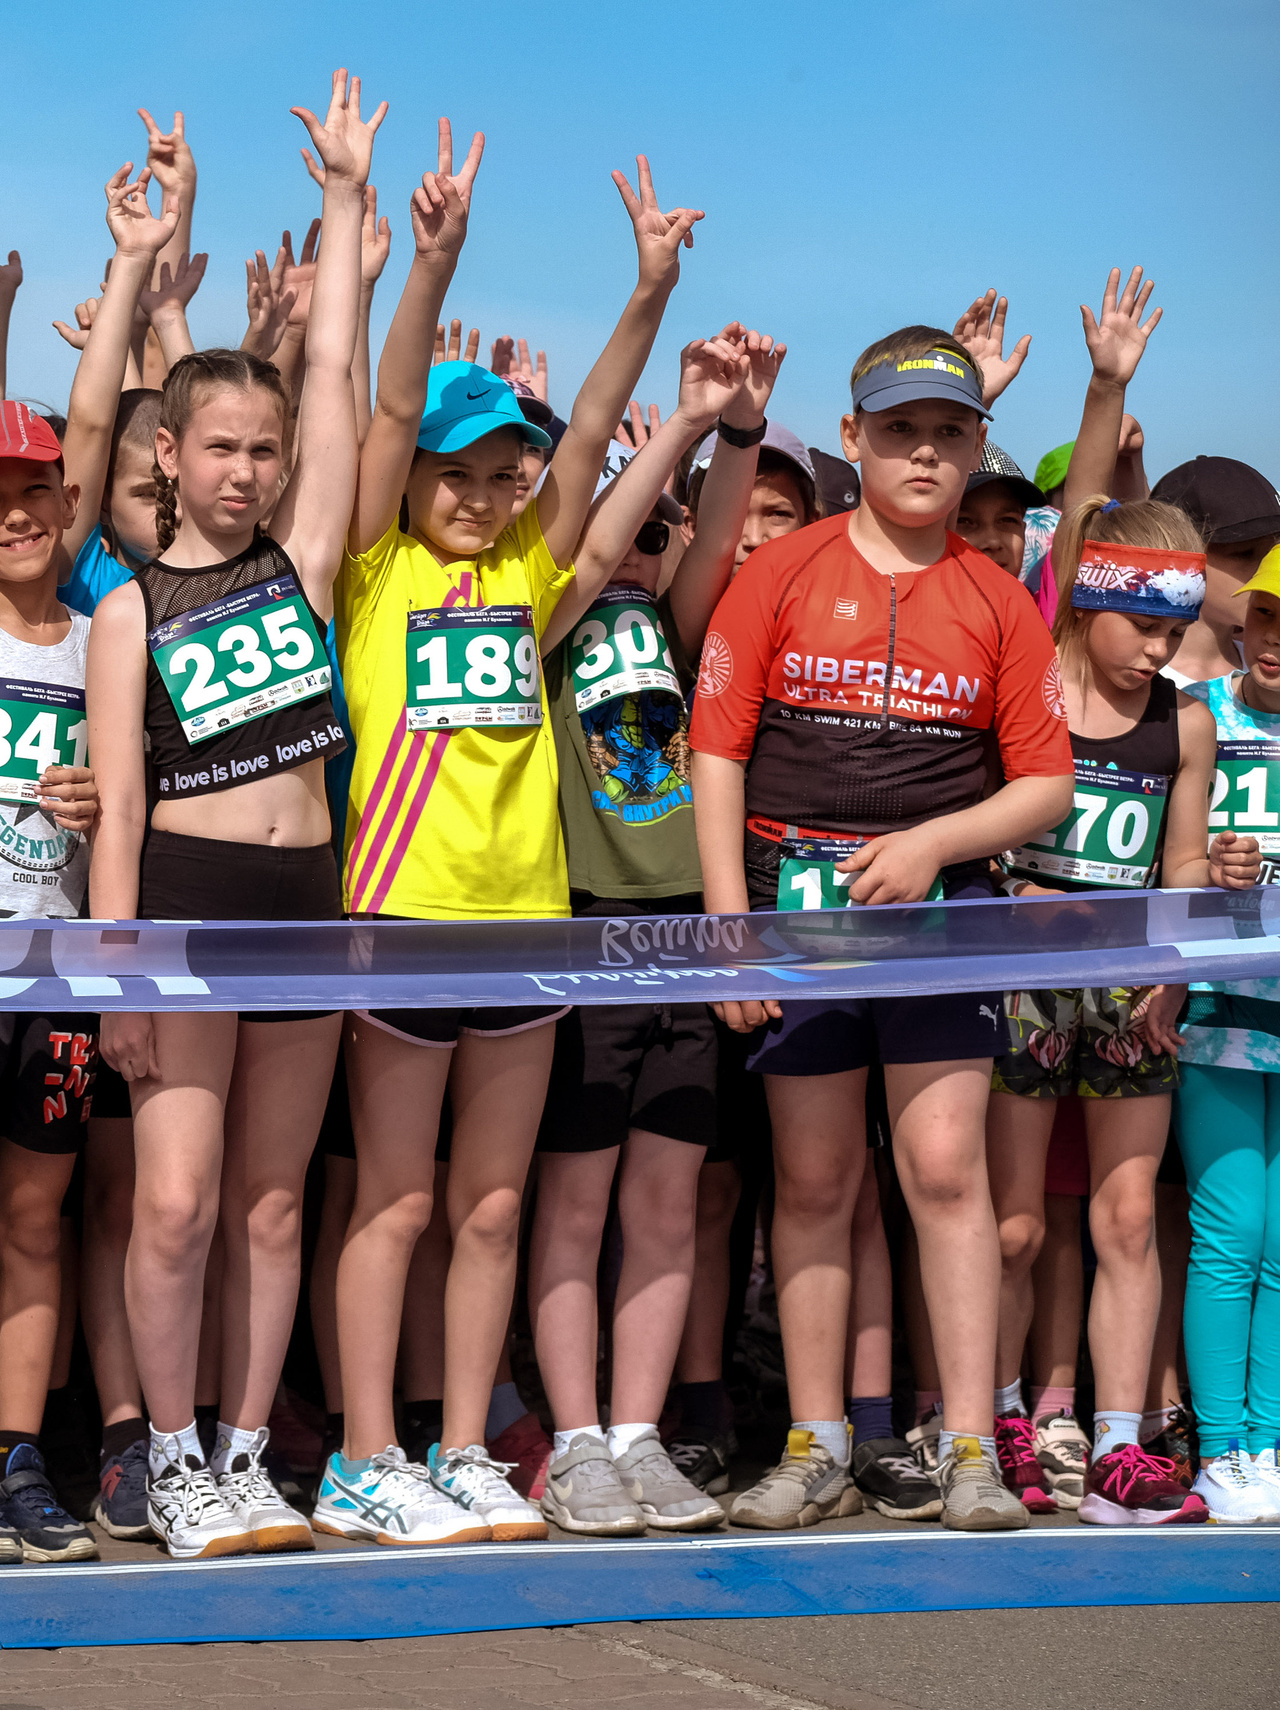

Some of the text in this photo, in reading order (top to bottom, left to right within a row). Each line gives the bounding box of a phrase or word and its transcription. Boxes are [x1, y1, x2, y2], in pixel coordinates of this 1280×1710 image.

[897, 356, 964, 379] IRONMAN
[169, 605, 314, 712] 235
[415, 634, 537, 700] 189
[783, 652, 980, 703] SIBERMAN
[783, 682, 973, 720] ULTRA TRIATHLON
[780, 709, 792, 719] 10
[795, 713, 812, 722] KM
[814, 715, 840, 726] SWIM
[843, 717, 861, 728] 421
[864, 720, 881, 730] KM
[925, 726, 941, 735] KM
[943, 729, 961, 739] RUN
[159, 725, 344, 792] ve love is love love is lo
[623, 790, 682, 822] ВНУТРИ
[1026, 791, 1148, 859] 70
[12, 872, 60, 886] COOL BOY
